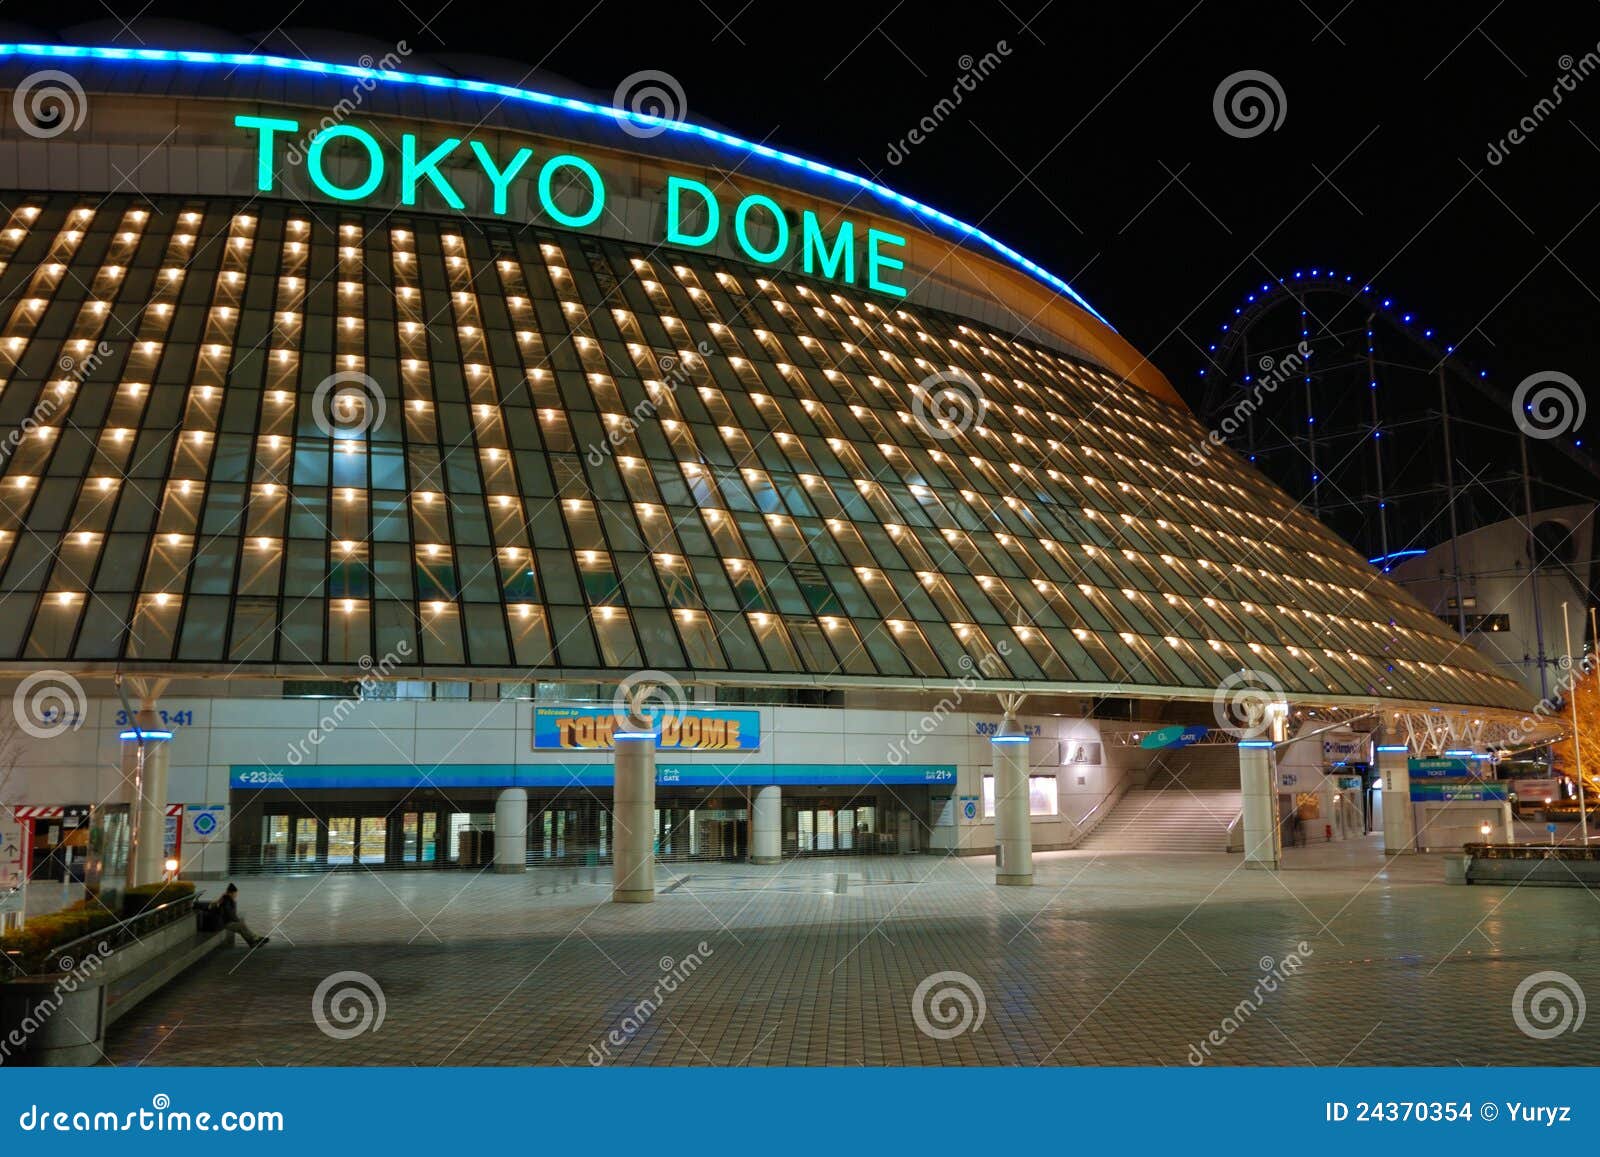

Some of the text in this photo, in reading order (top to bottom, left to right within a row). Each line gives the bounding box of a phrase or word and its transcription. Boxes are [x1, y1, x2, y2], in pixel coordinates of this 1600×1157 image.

[234, 115, 907, 297] TOKYO DOME
[661, 716, 741, 749] DOME
[250, 771, 268, 783] 23
